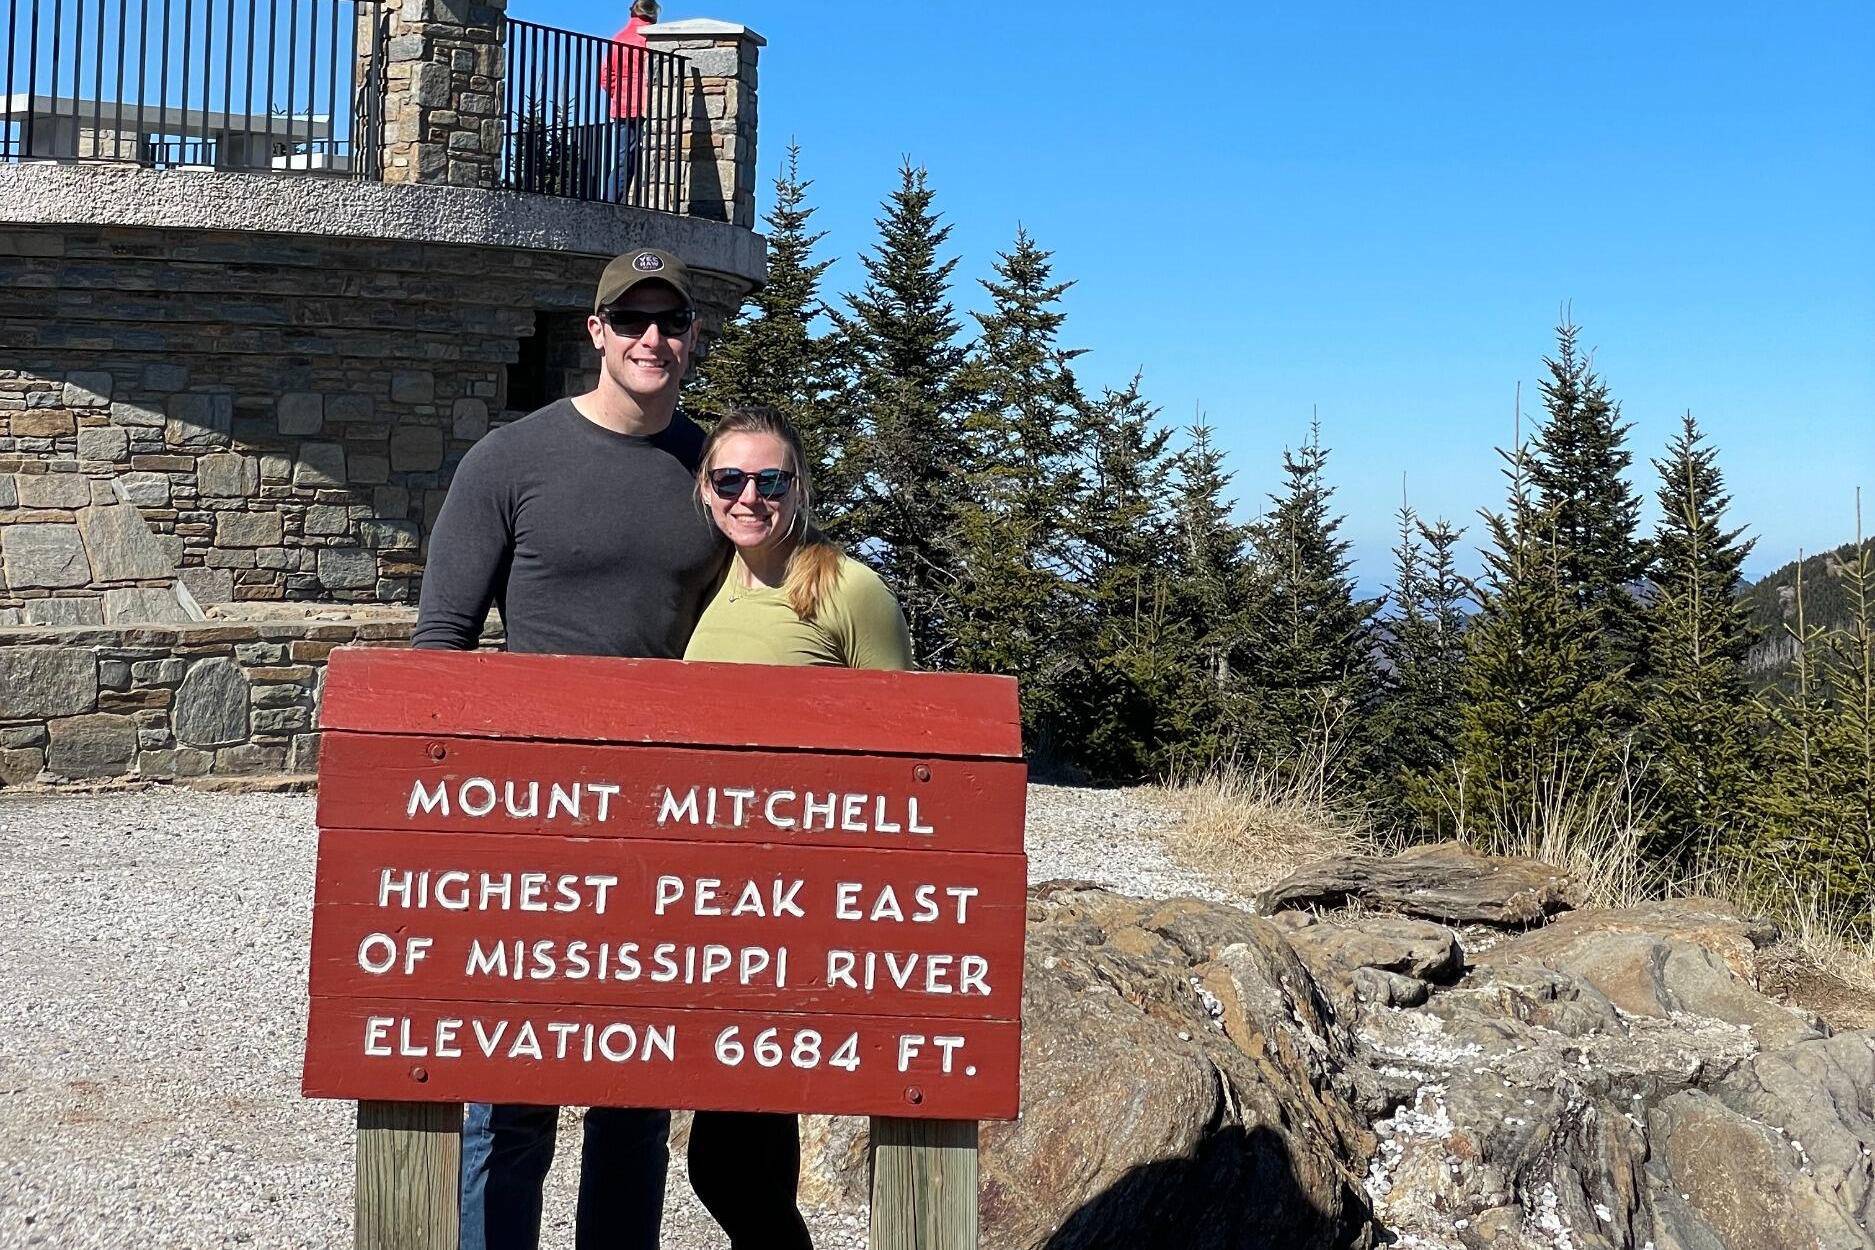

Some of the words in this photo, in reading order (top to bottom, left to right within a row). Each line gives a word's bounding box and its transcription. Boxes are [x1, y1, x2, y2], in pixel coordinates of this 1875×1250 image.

[406, 776, 620, 822] MOUNT
[656, 786, 935, 835] MITCHELL
[378, 868, 619, 916] HIGHEST
[654, 875, 806, 919] PEAK
[835, 882, 980, 925] EAST
[357, 932, 435, 976] OF
[465, 938, 788, 988] MISSISSIPPI
[826, 949, 993, 997] RIVER
[364, 1015, 677, 1063] ELEVATION
[714, 1026, 862, 1072] 6684
[897, 1034, 978, 1077] FT.
